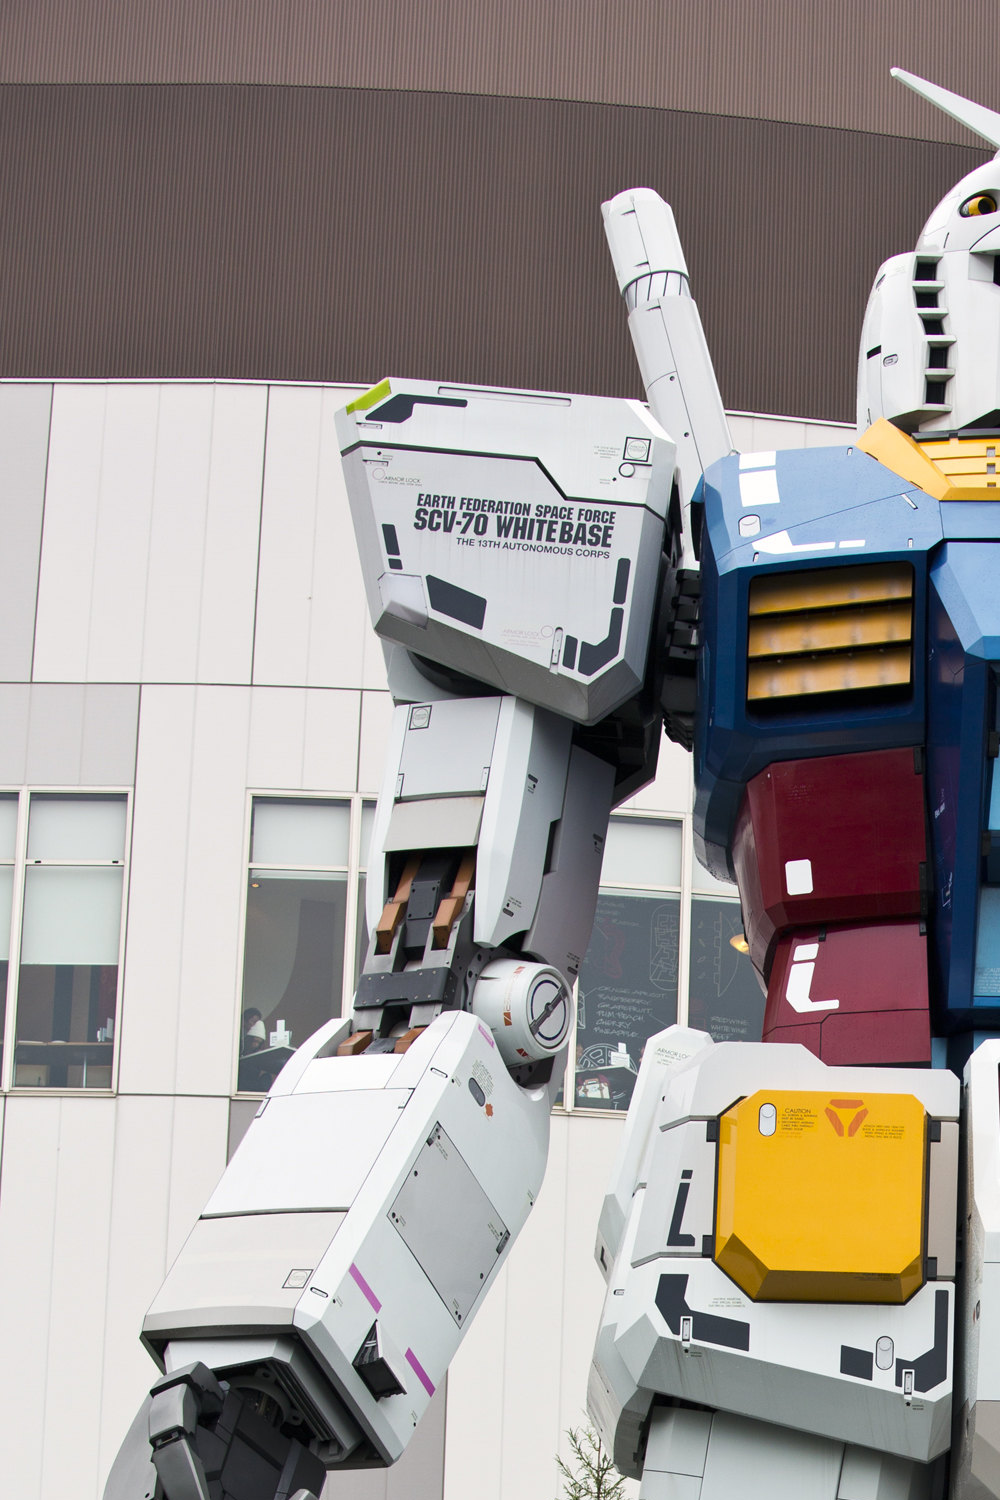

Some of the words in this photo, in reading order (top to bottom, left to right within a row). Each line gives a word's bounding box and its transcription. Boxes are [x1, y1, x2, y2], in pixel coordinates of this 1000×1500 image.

[413, 507, 489, 536] SCV-70
[417, 493, 456, 509] EARTH
[459, 497, 531, 517] FEDERATION
[535, 504, 574, 521] SPACE
[577, 508, 616, 524] FORCE
[456, 537, 475, 547] THE
[478, 539, 500, 549] 13TH
[502, 542, 574, 556] AUTONOMOUS
[575, 548, 610, 560] CORPS
